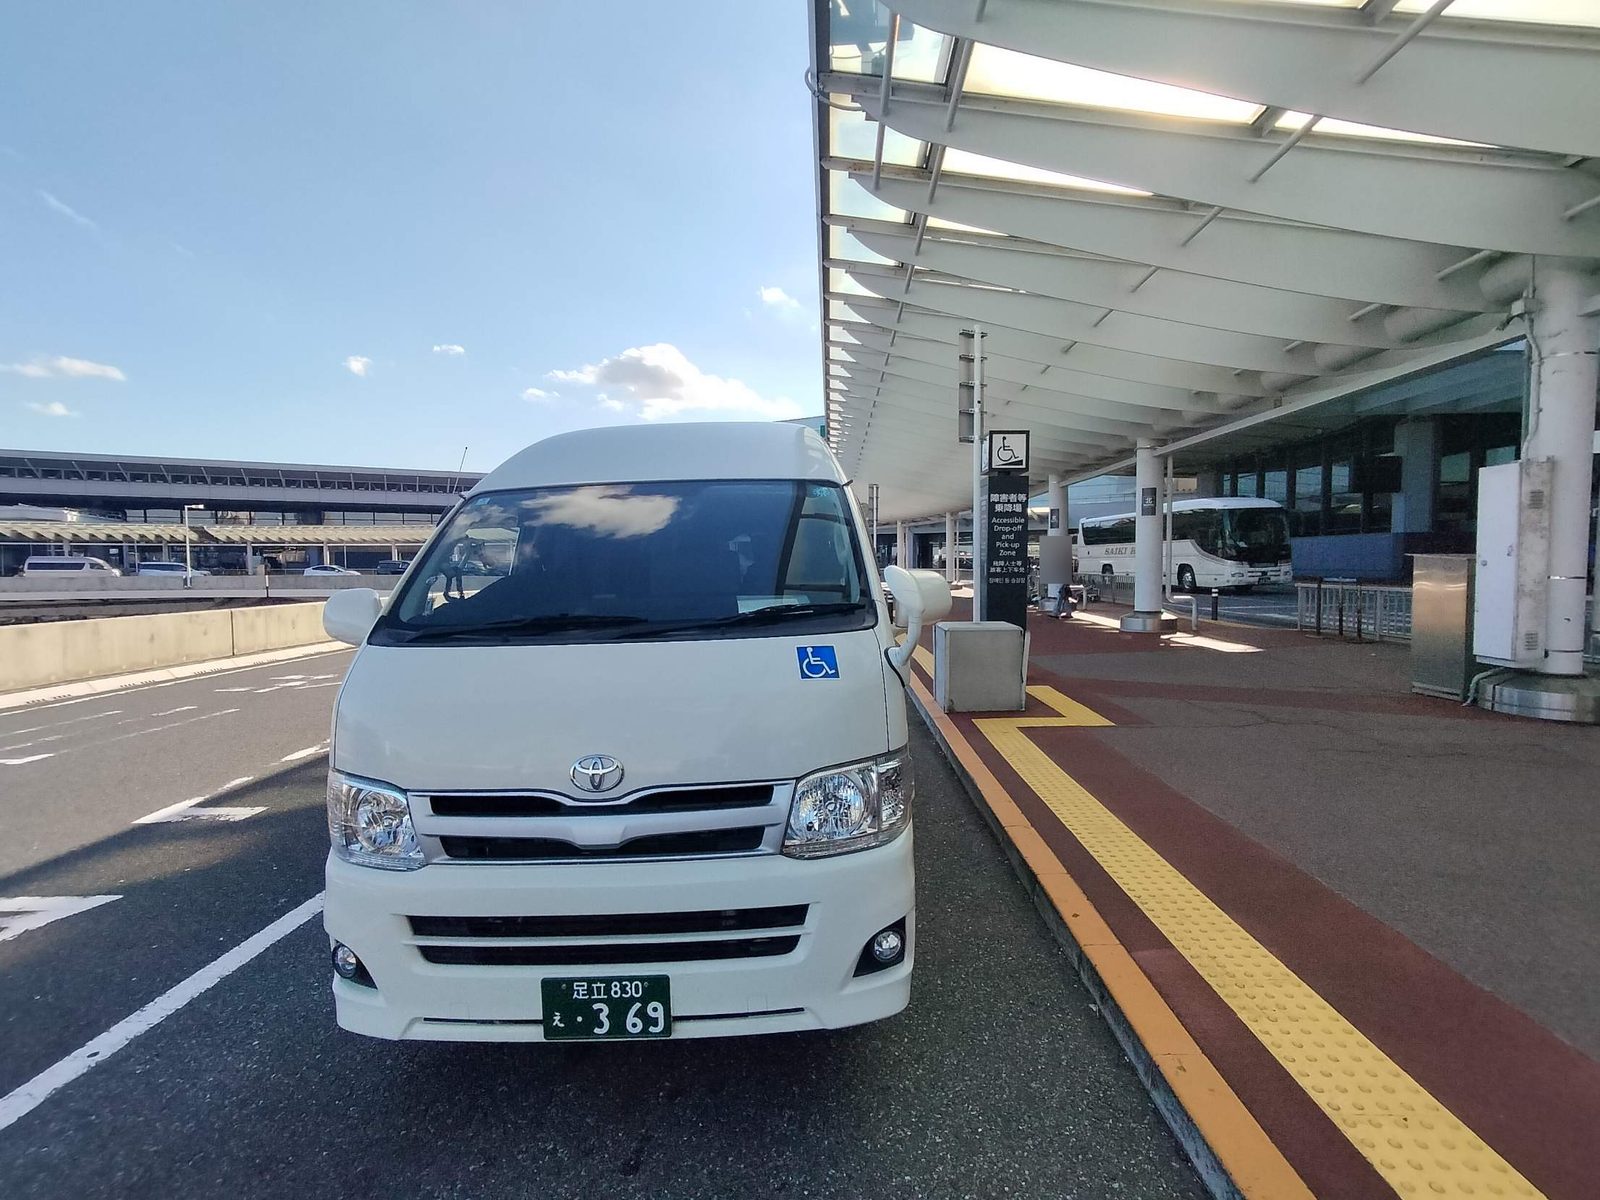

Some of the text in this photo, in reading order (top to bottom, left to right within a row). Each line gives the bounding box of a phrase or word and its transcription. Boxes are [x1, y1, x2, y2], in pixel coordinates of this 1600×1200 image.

[990, 493, 1027, 502] 障害者等
[994, 504, 1023, 513] 乗降場
[991, 516, 1025, 524] Accessible
[994, 525, 1022, 533] Drop-off
[572, 981, 642, 999] 足立 830
[552, 1012, 565, 1028] え
